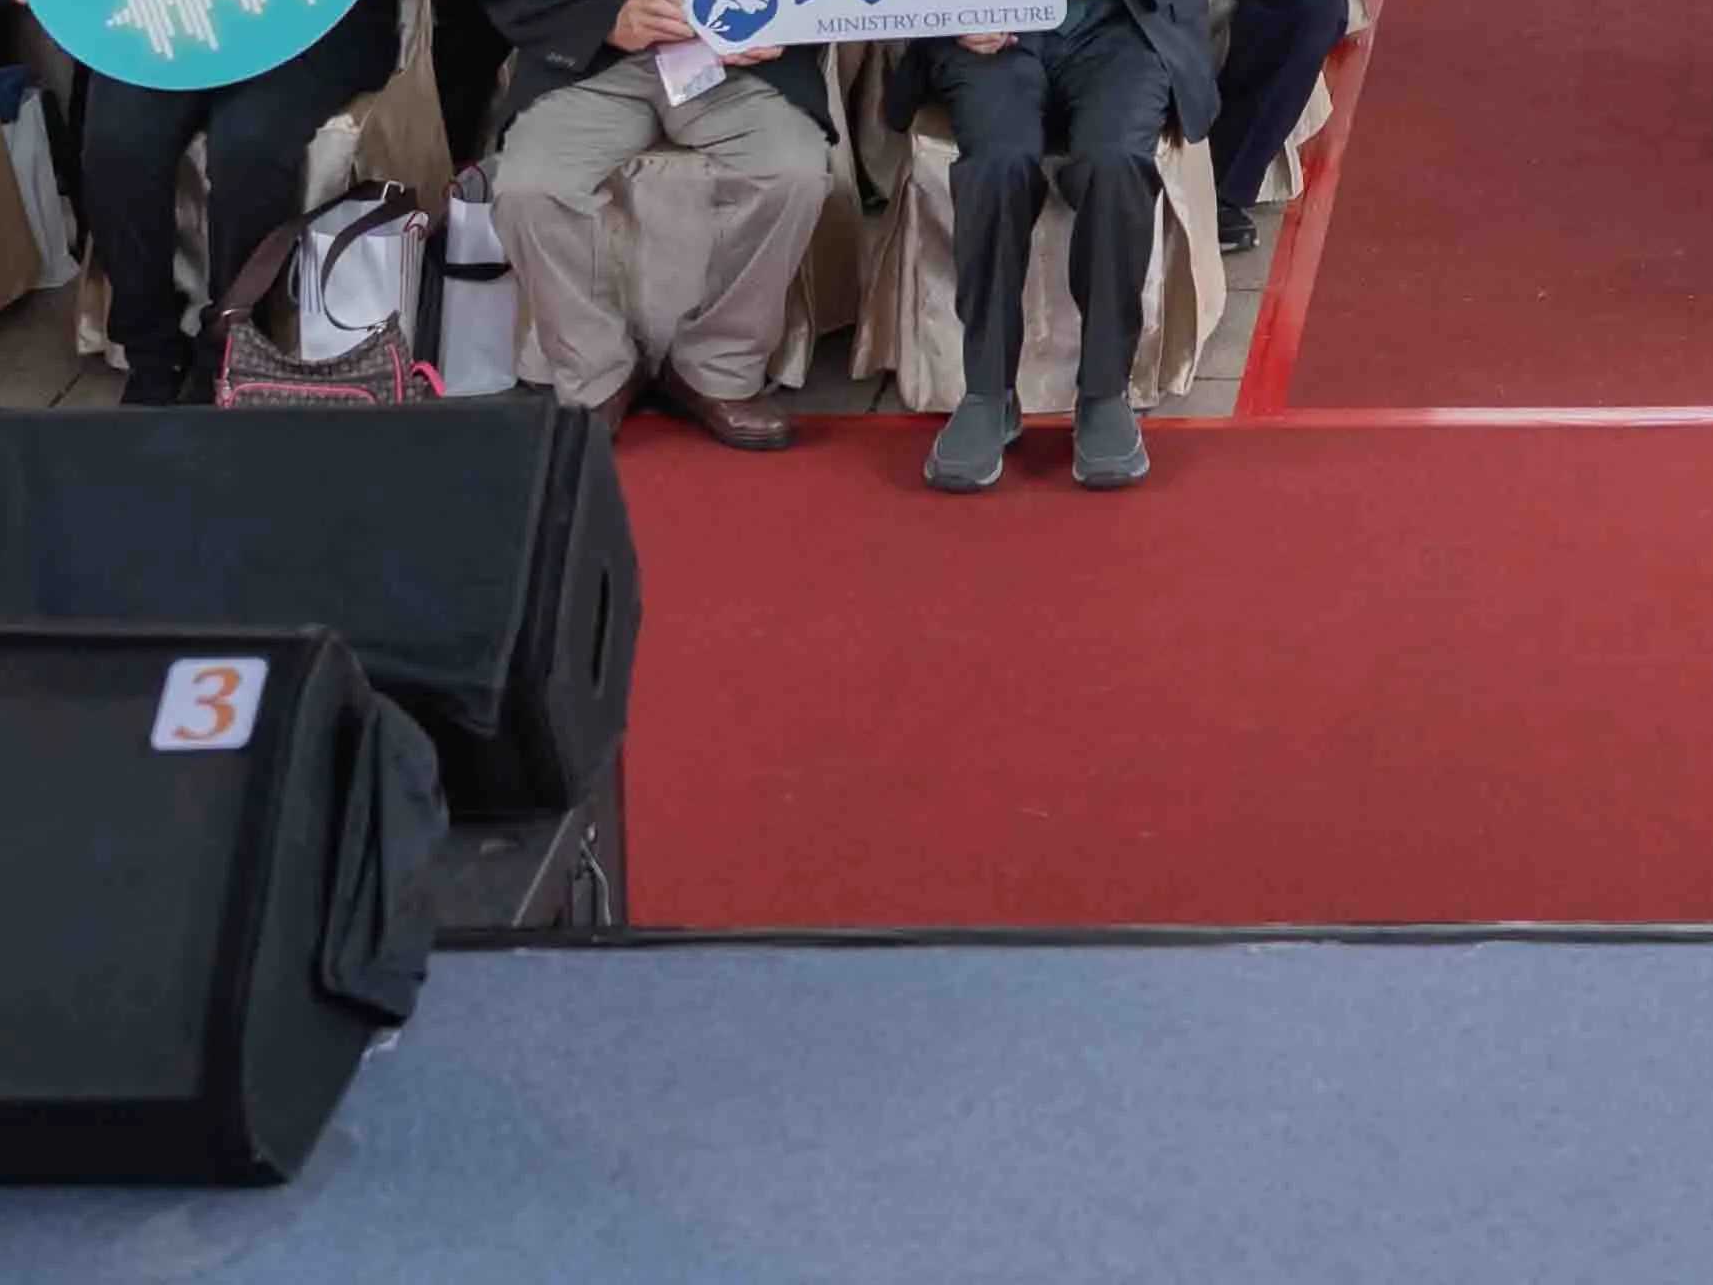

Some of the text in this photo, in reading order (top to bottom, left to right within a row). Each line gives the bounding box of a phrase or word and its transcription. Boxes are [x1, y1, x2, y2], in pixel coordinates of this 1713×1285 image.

[817, 6, 1056, 33] MINISTRY OF CULTURE
[172, 666, 243, 741] 3
